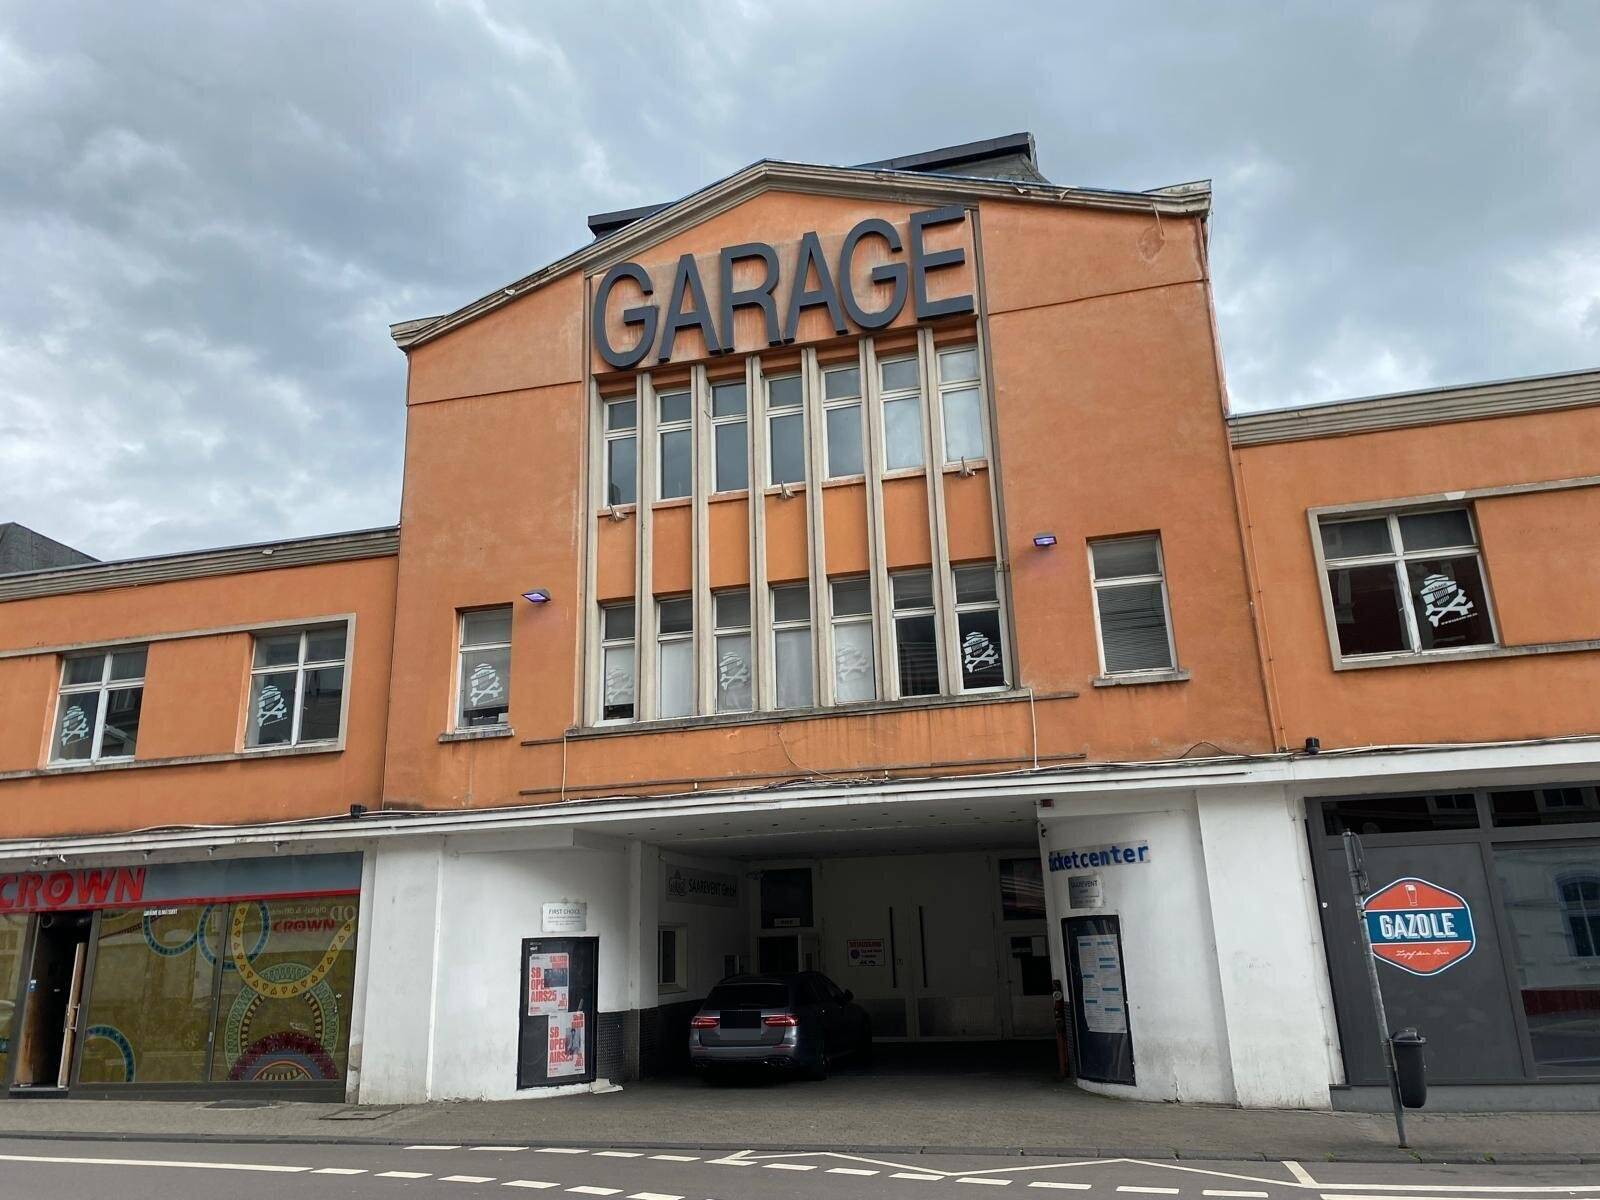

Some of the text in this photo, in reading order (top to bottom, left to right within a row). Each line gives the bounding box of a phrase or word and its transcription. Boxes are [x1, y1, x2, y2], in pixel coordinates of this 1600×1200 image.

[594, 205, 974, 370] GARAGE
[0, 867, 146, 908] CROWN
[272, 918, 336, 933] CROWN
[1379, 912, 1458, 939] GAZOLE
[531, 967, 541, 978] SB
[531, 990, 557, 1003] AIRS25
[550, 1027, 560, 1038] SB
